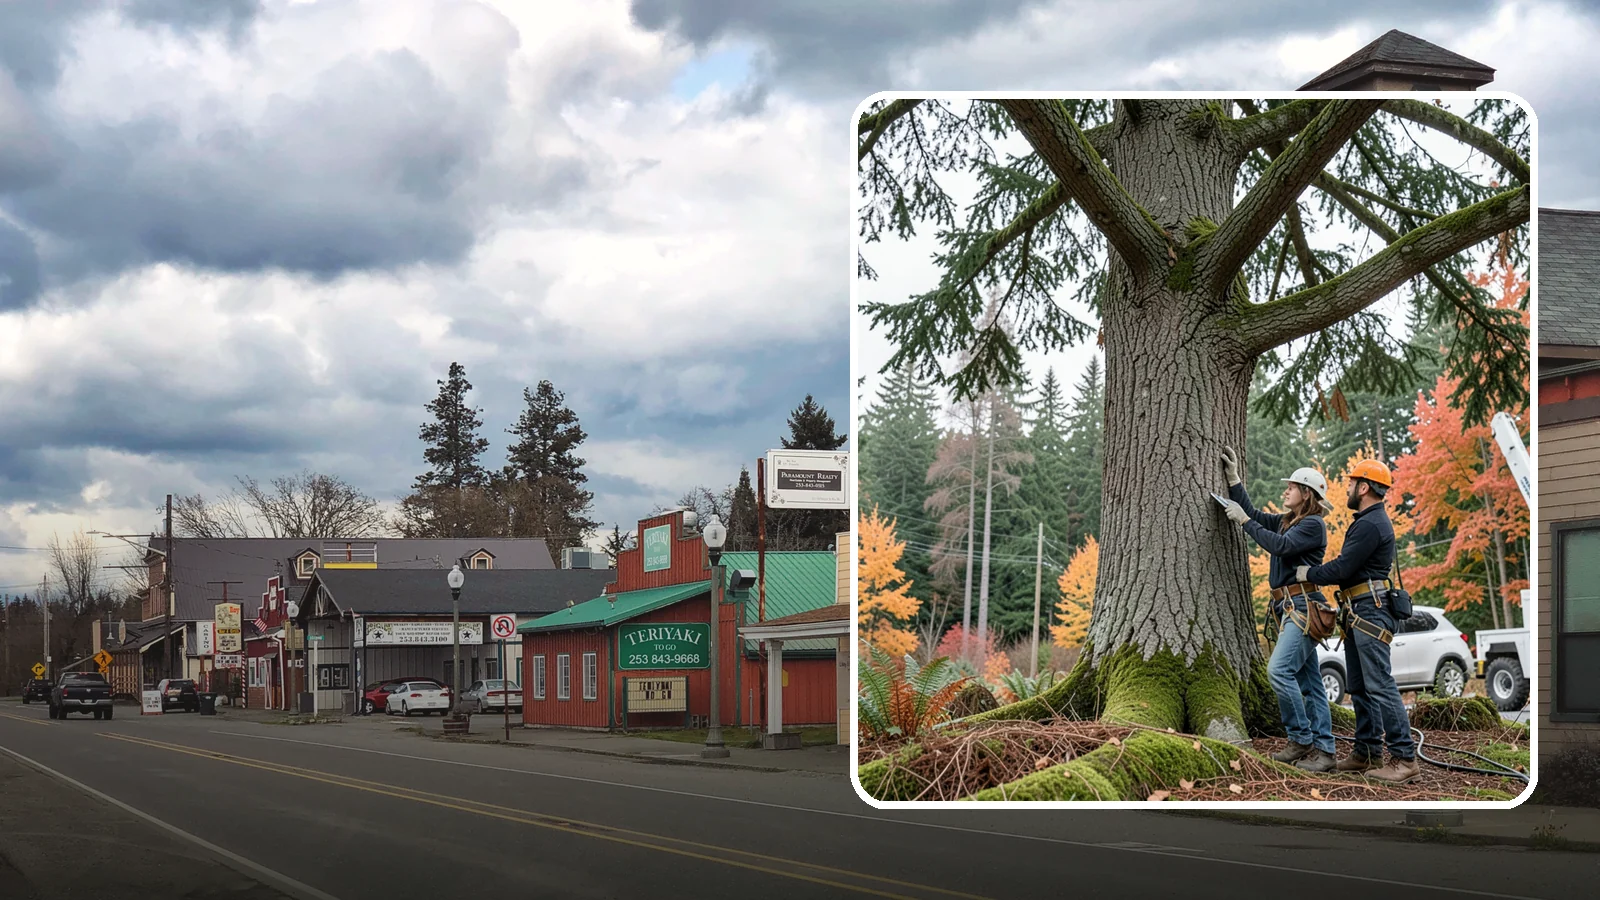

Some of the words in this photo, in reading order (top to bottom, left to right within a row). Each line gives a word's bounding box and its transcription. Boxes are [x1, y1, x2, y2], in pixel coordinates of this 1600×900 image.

[625, 627, 702, 645] TERIYAKI
[666, 643, 676, 651] GO
[628, 654, 648, 664] 253
[651, 653, 700, 664] 843-9668
